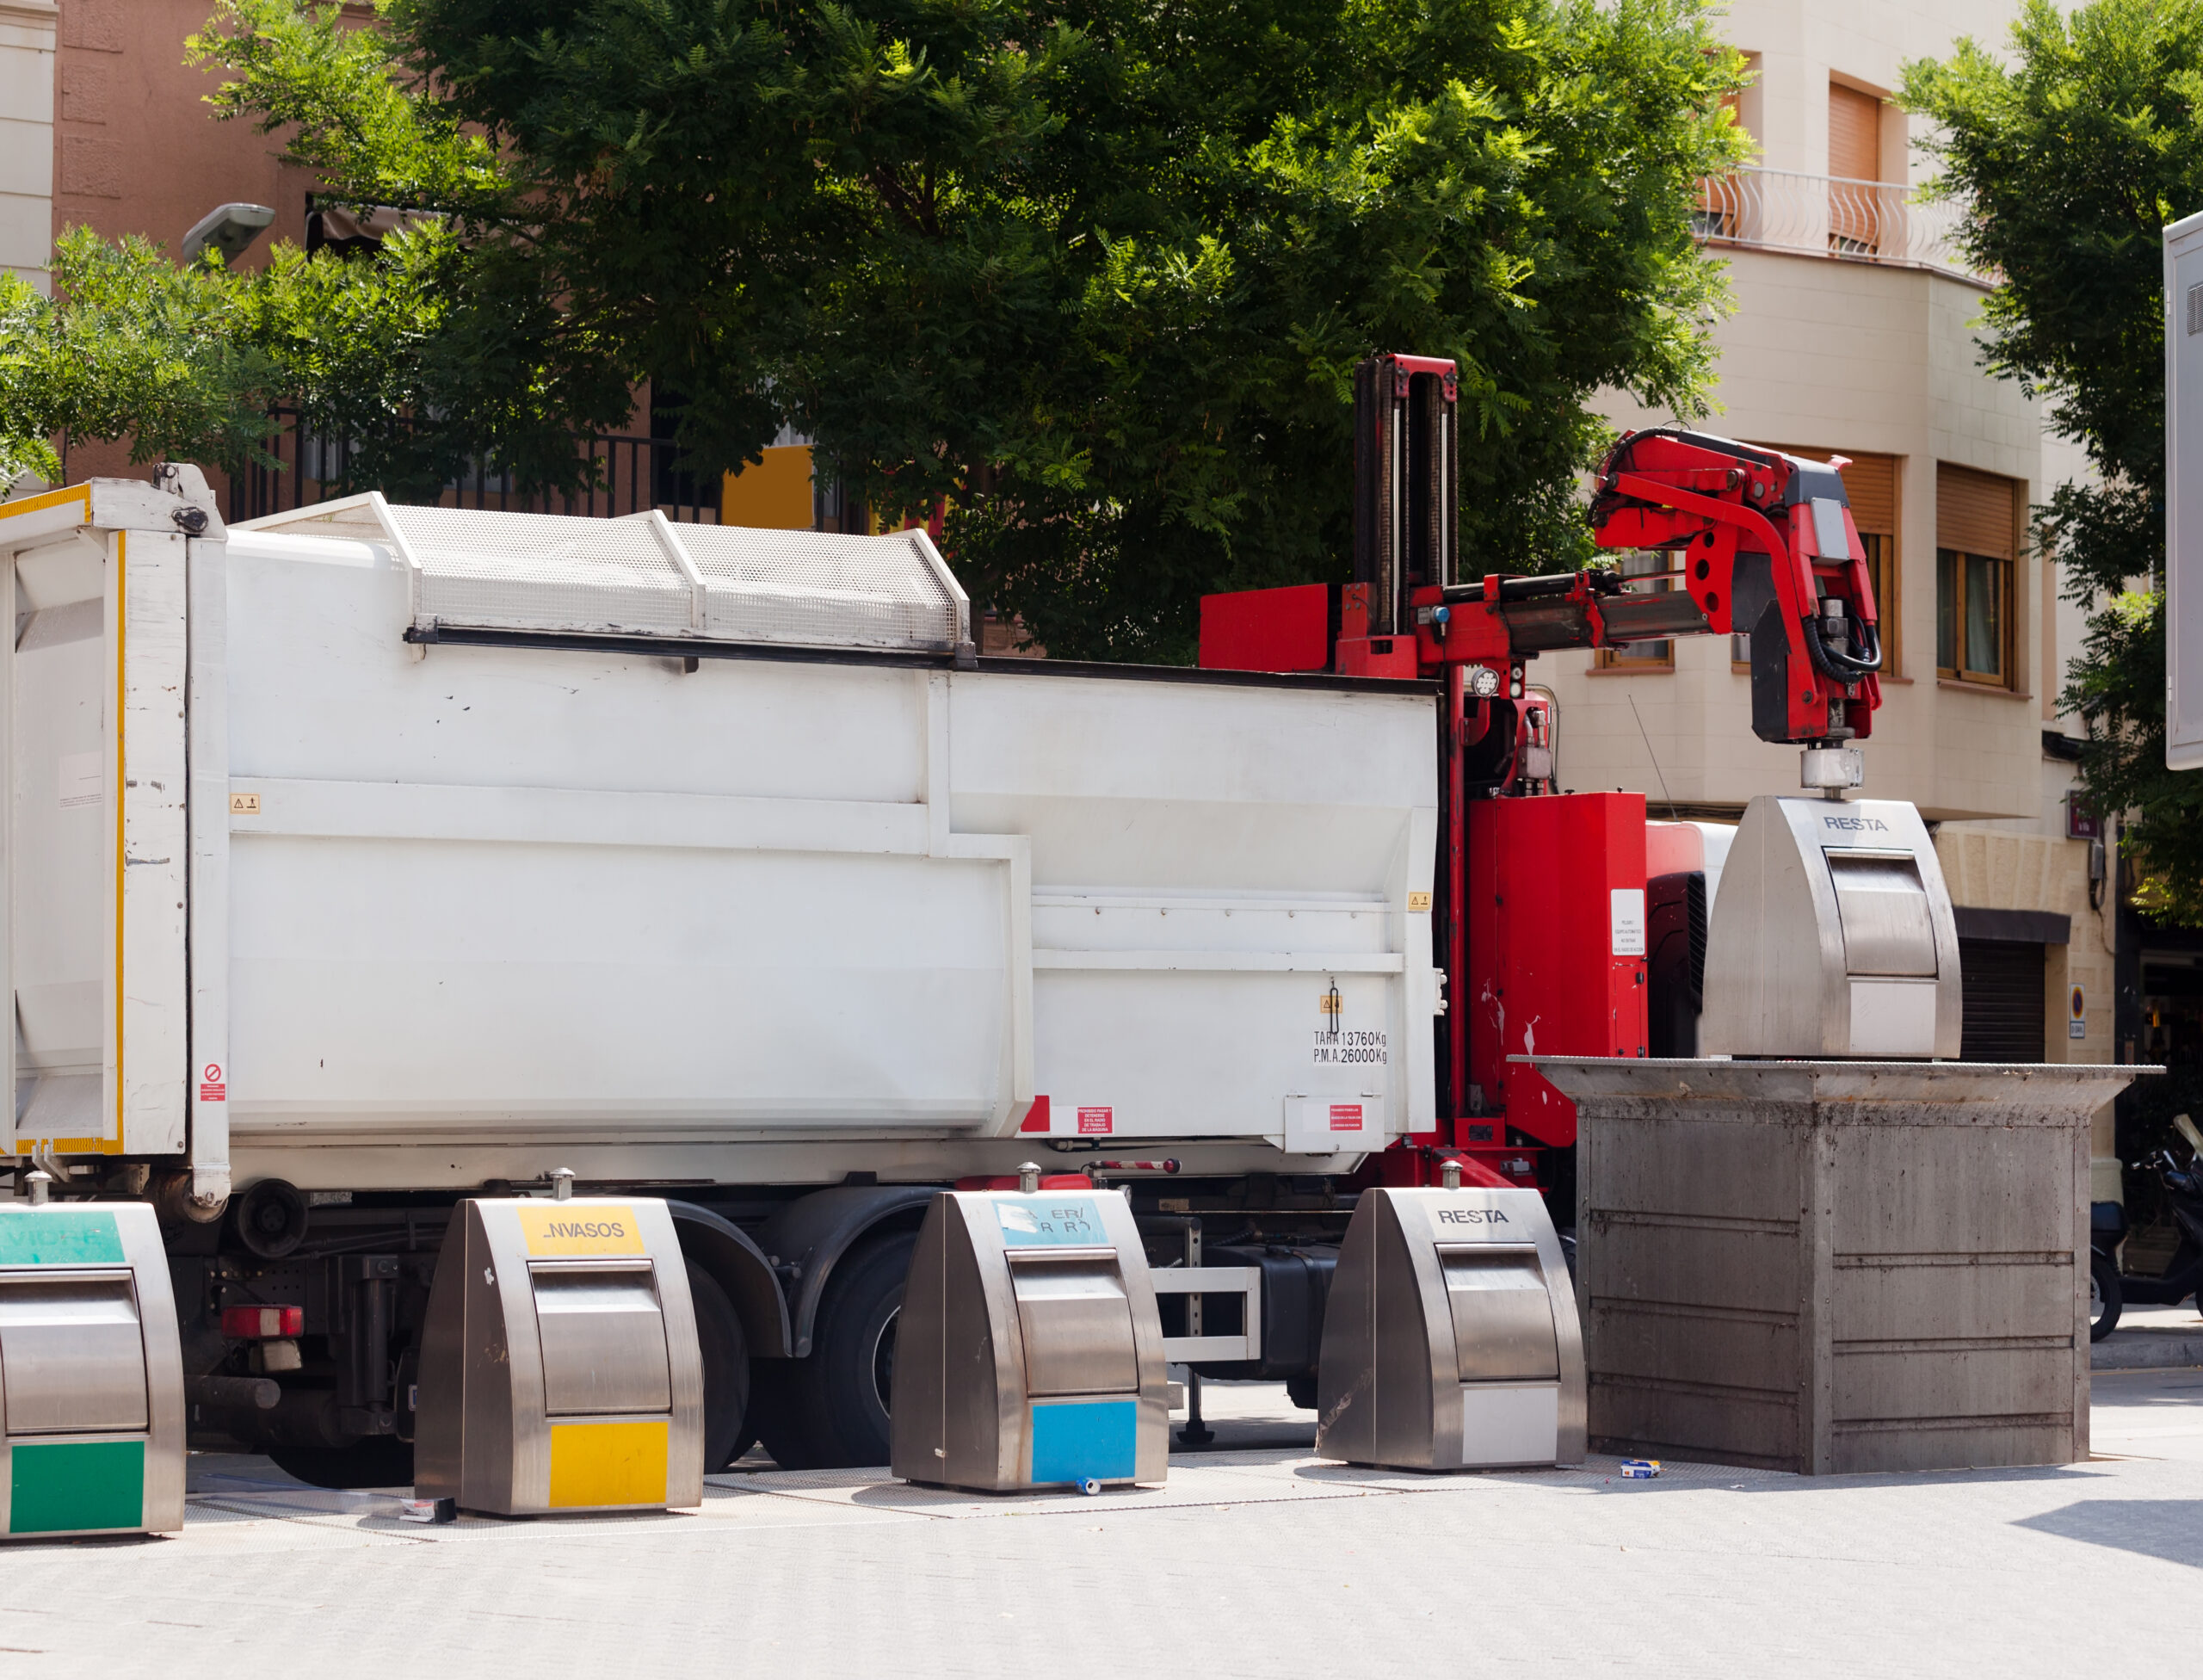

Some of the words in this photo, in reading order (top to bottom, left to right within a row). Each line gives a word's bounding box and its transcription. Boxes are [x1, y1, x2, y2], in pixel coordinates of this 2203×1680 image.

[1823, 817, 1888, 831] RESTA
[1314, 1031, 1339, 1045] TARA
[1436, 1210, 1509, 1224] RESTA
[543, 1222, 625, 1238] NVASOS
